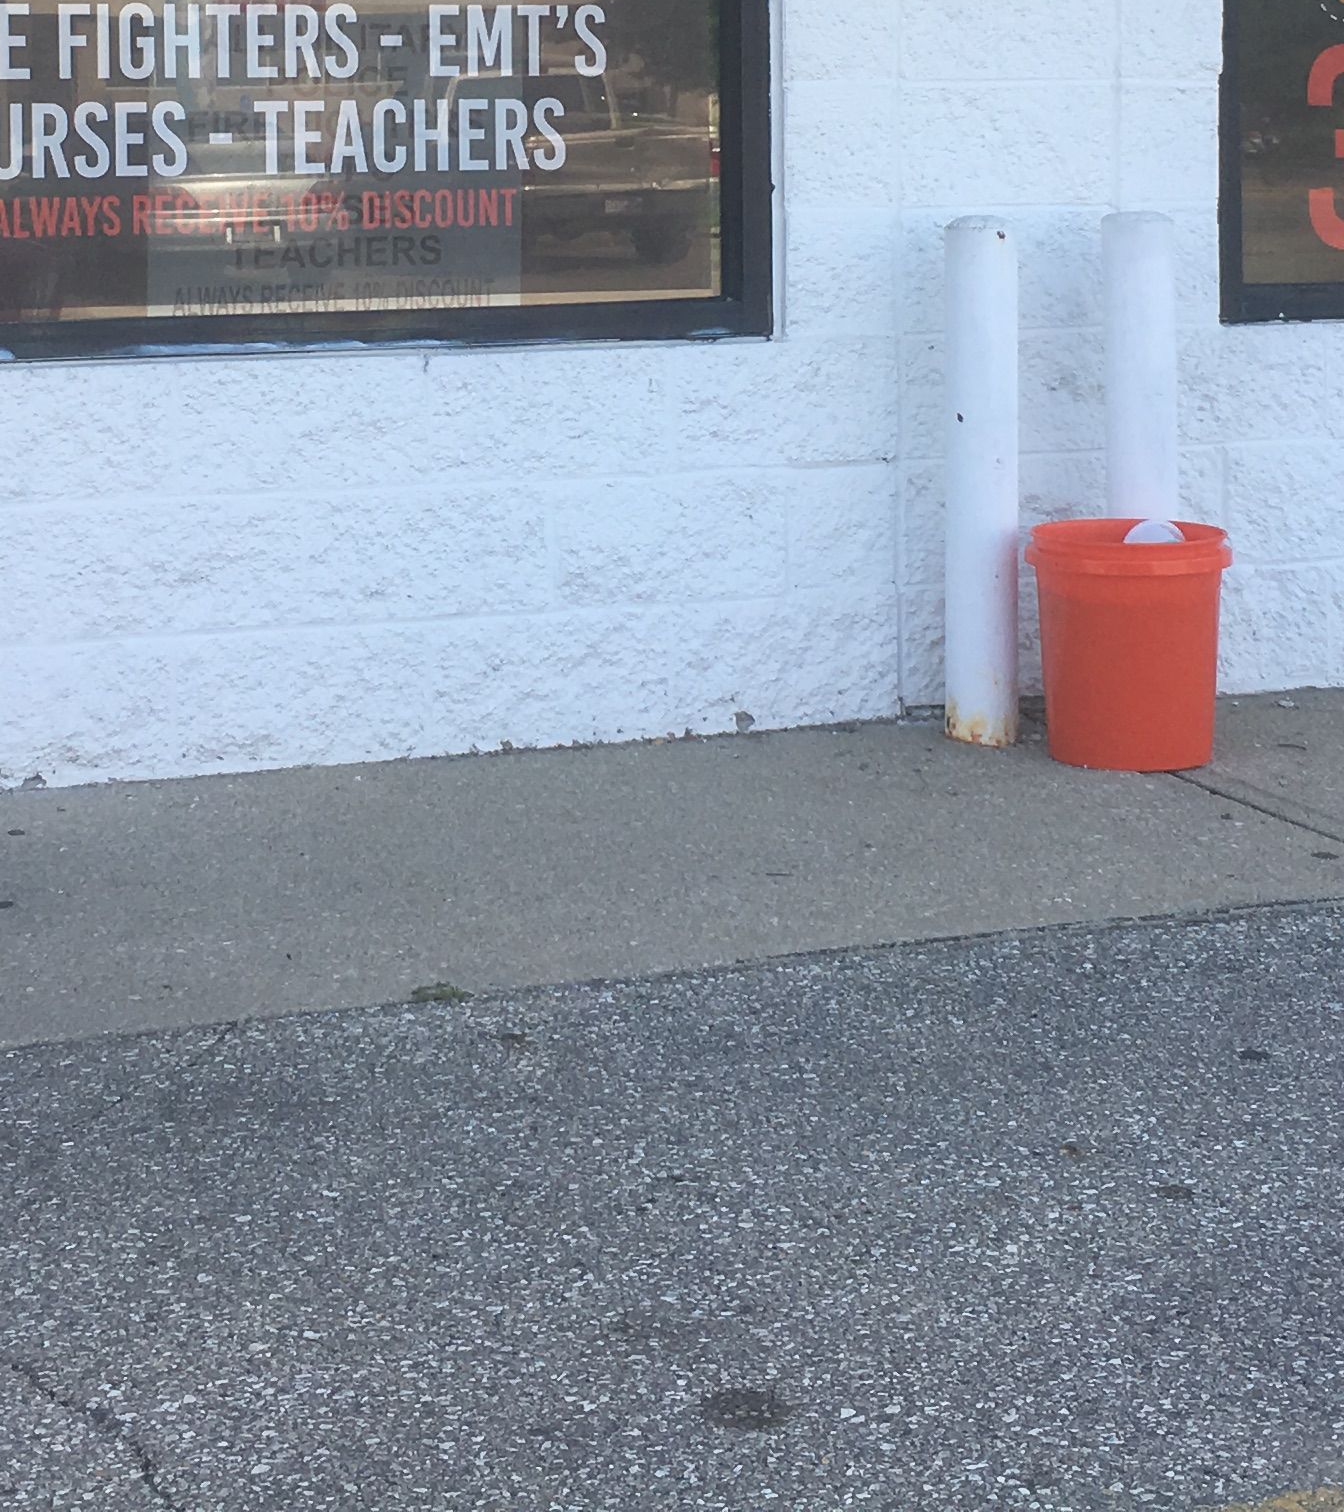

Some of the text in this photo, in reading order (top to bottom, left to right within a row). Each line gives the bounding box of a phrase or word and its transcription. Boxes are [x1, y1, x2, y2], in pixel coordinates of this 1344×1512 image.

[58, 2, 359, 80] FIGHTERS
[429, 3, 608, 78] EMT'S
[253, 95, 567, 176] TEACHERS
[133, 192, 270, 238] RECEIVE
[277, 190, 350, 234] 10%
[362, 187, 517, 230] DISCOUNT
